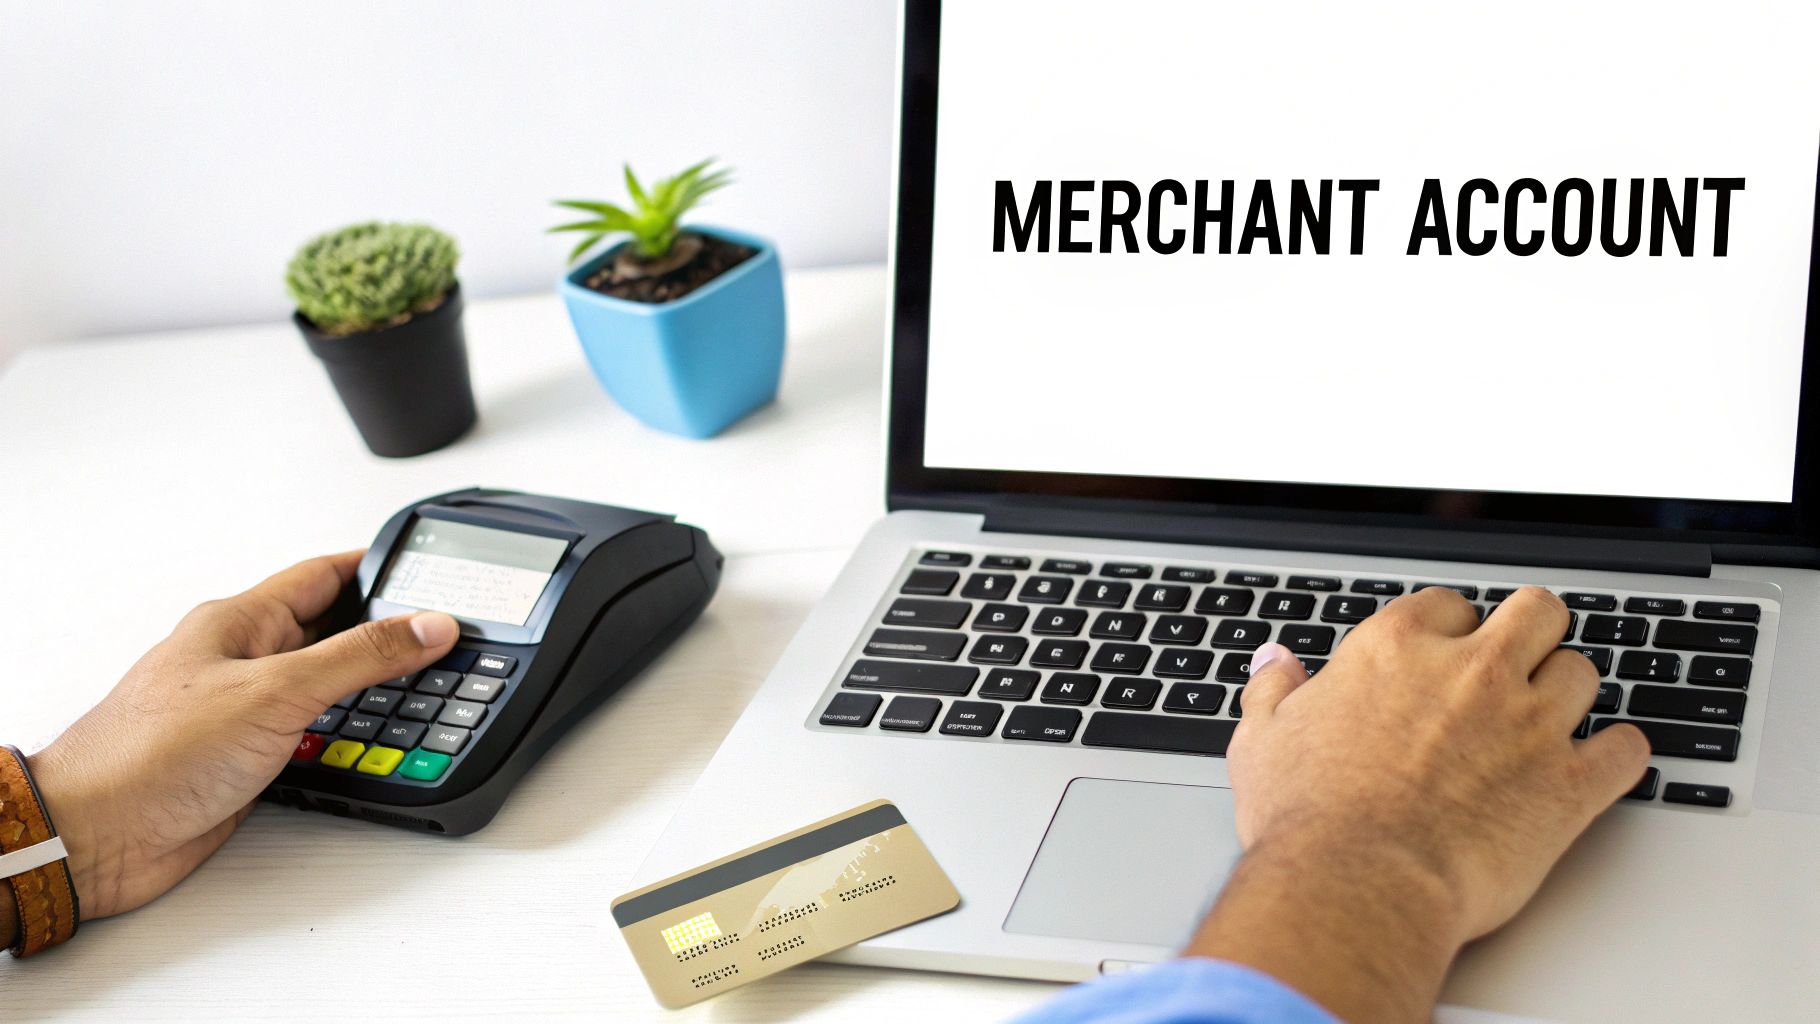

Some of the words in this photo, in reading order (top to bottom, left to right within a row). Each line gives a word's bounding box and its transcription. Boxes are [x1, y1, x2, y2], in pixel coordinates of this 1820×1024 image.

[993, 179, 1380, 255] MERCHANT
[1407, 178, 1745, 257] ACCOUNT
[1170, 624, 1183, 635] V
[1233, 628, 1246, 639] D
[1121, 687, 1137, 699] R
